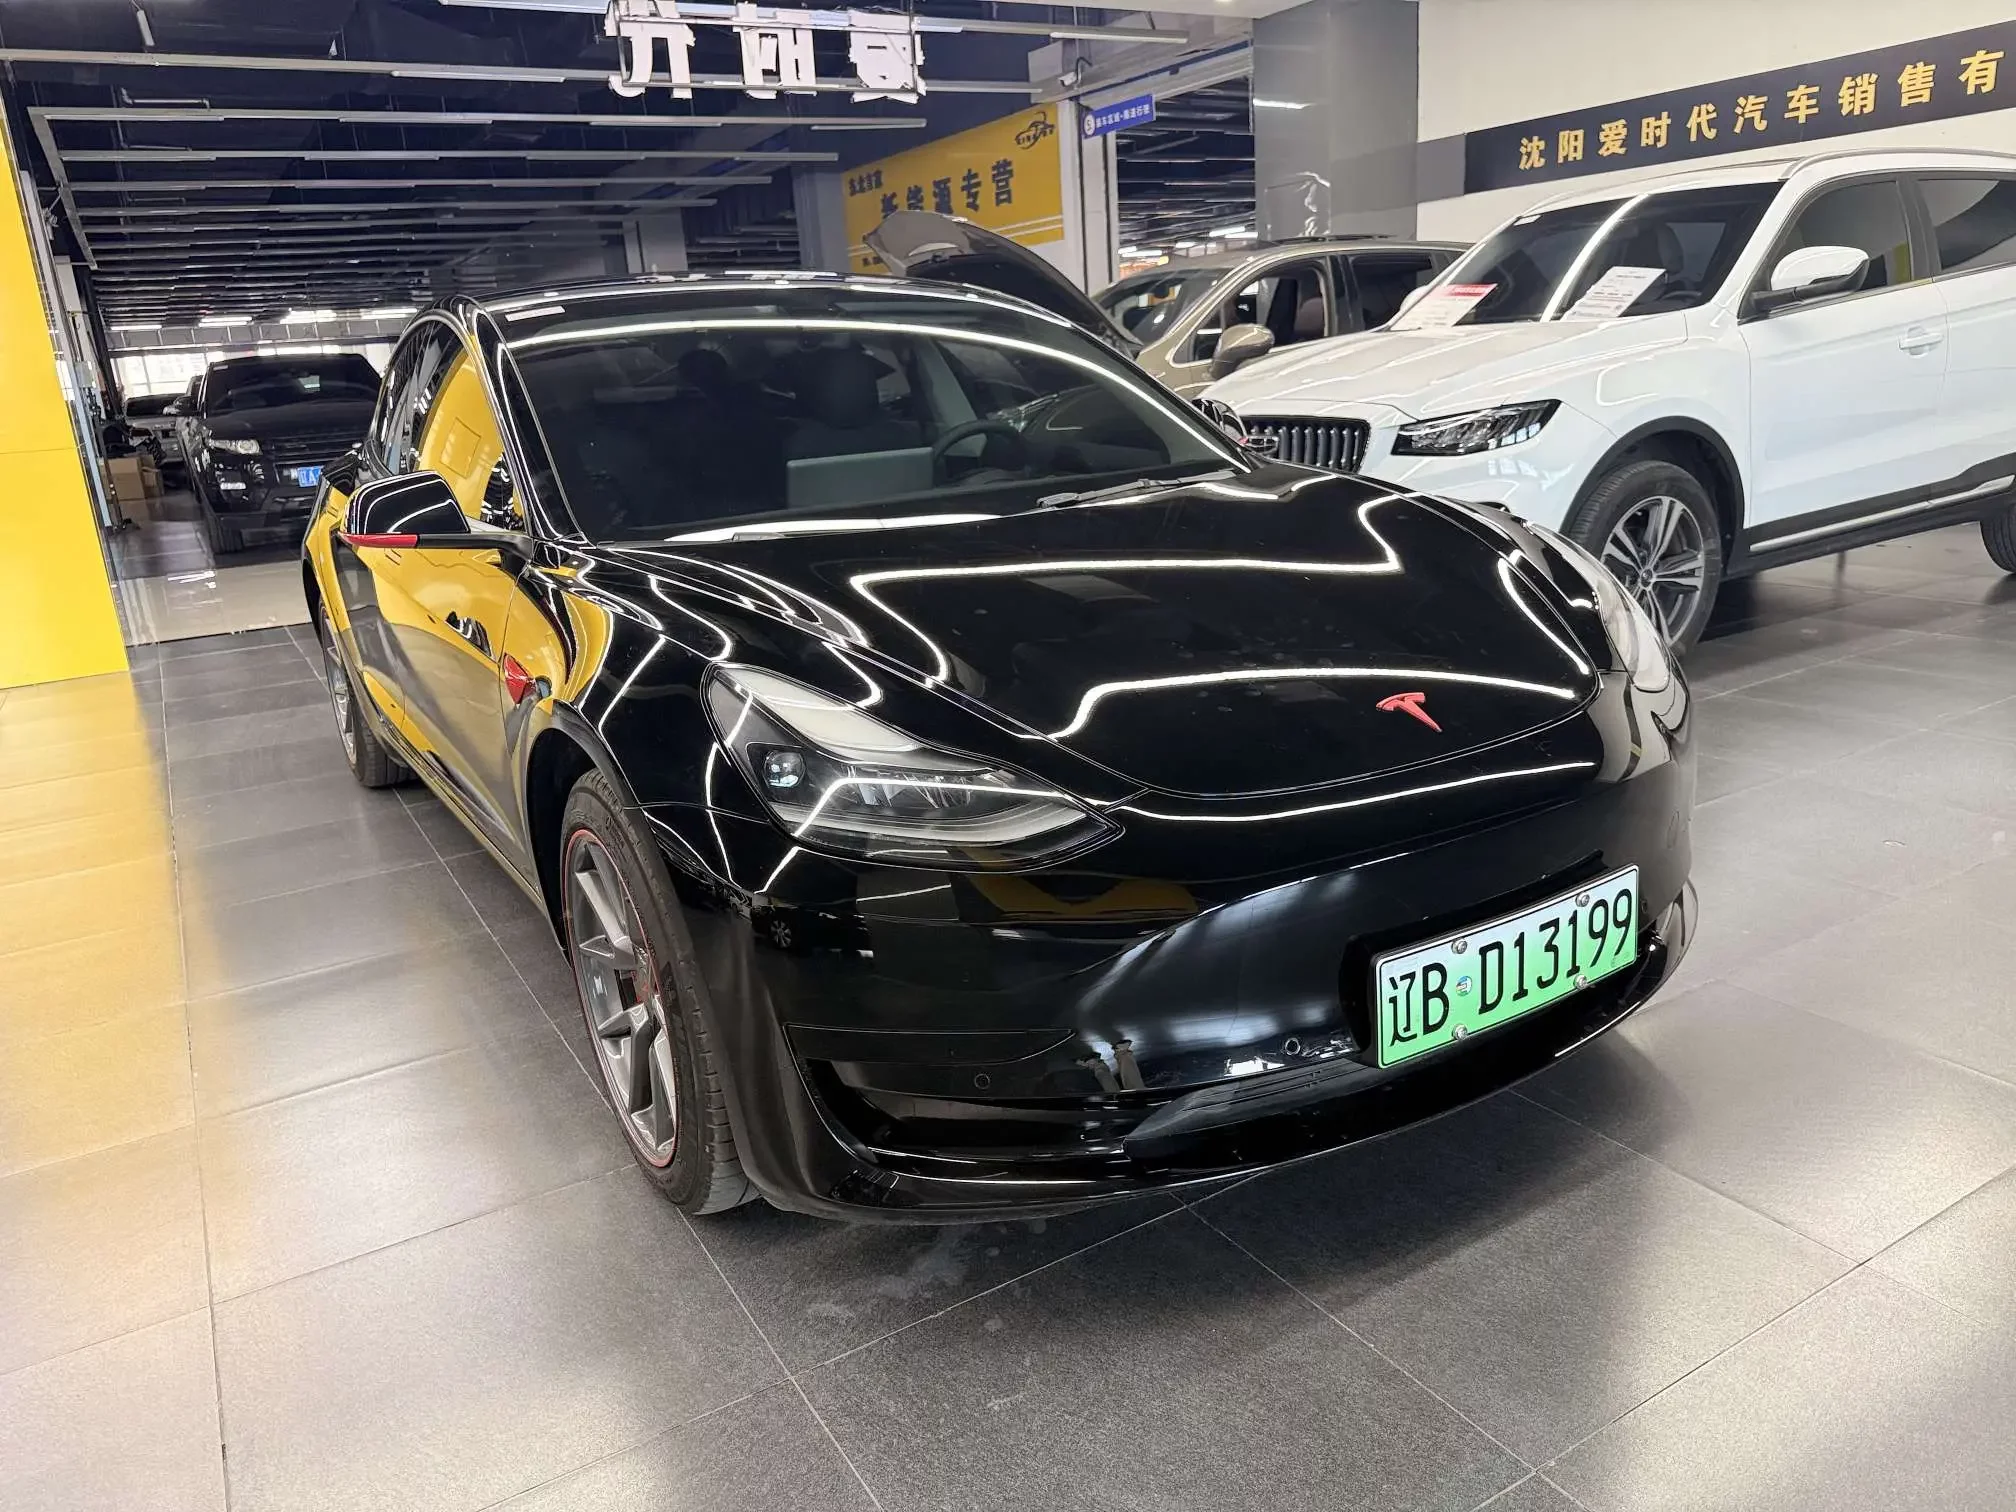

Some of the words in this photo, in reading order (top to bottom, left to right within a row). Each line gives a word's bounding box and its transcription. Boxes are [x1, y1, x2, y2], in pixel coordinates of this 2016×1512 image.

[1518, 49, 2005, 171] 沈阳爱时代汽车销售有
[1478, 888, 1634, 1016] D13199
